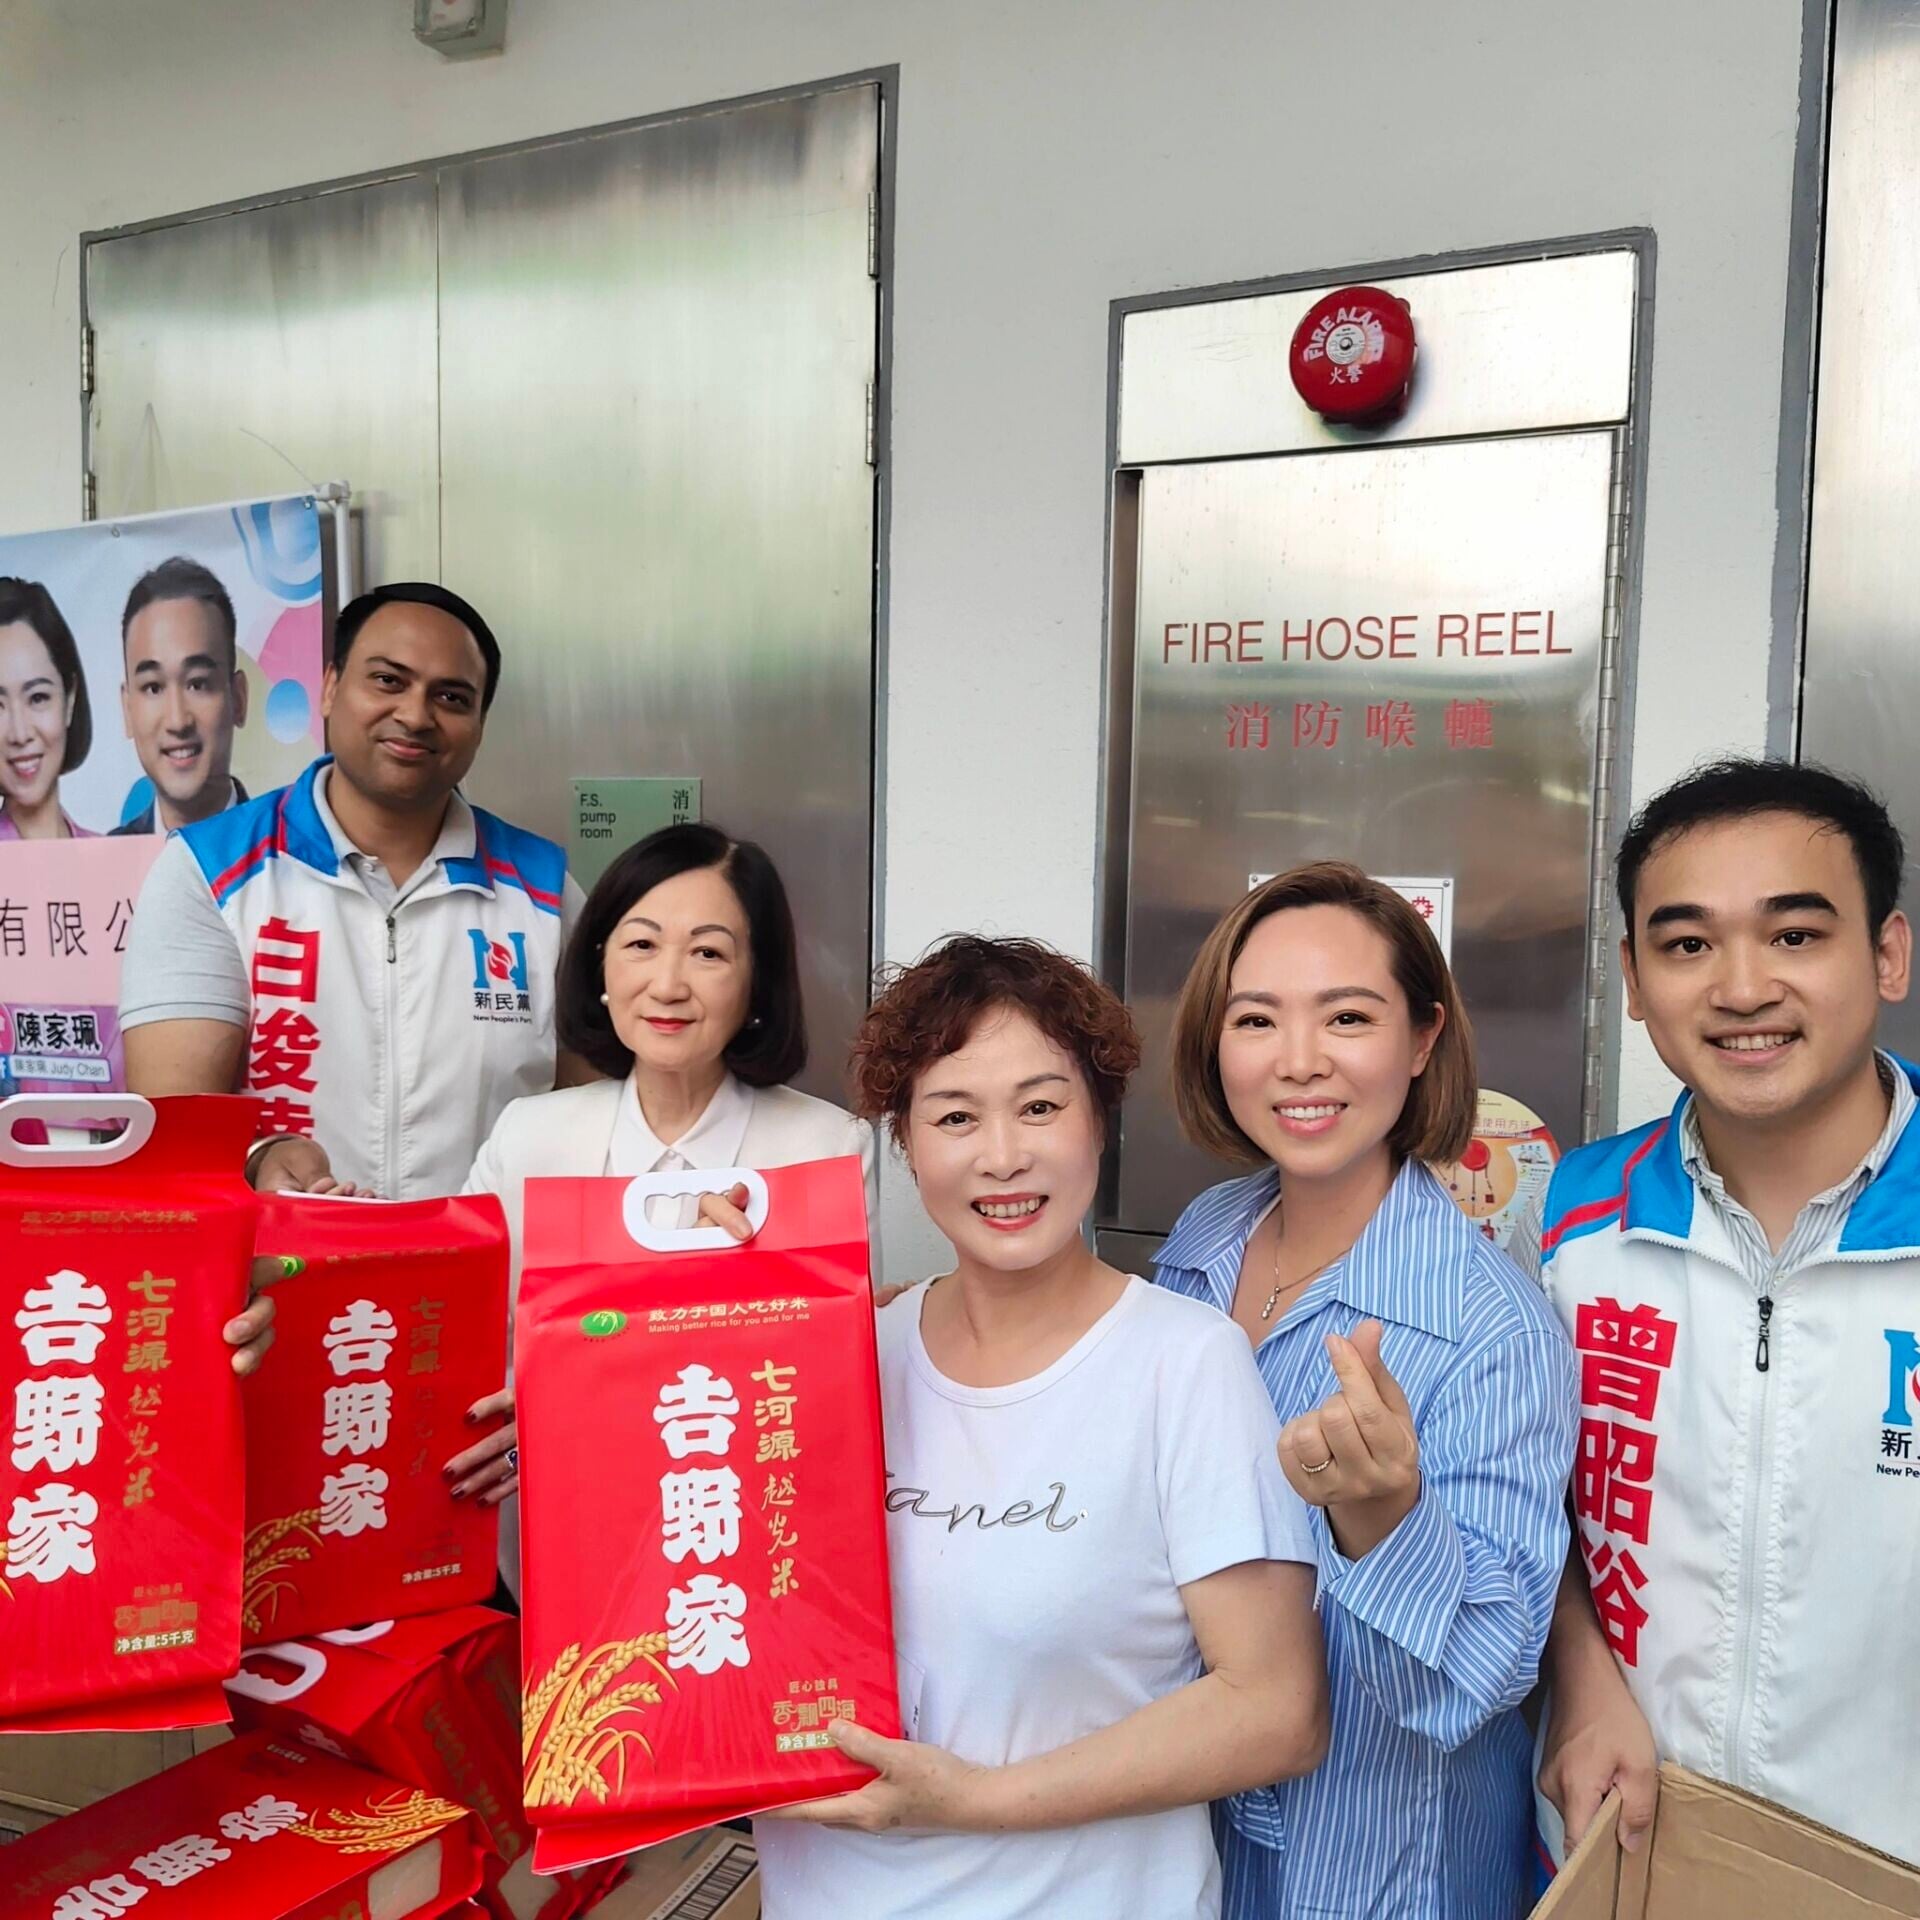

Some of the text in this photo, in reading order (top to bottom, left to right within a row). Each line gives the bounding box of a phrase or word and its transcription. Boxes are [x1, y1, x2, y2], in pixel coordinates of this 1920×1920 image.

[1303, 316, 1336, 363] FIRE
[1329, 366, 1363, 385] 火警
[1163, 610, 1573, 664] FIRE HOSE REEL
[1224, 697, 1496, 751] 消防喉轆
[580, 793, 602, 807] F.S.
[580, 812, 616, 825] pump
[580, 827, 613, 838] room
[16, 1012, 100, 1051] 陳家珮
[51, 1061, 75, 1078] Judy
[76, 1062, 105, 1077] Chan
[648, 1297, 809, 1323] 致力于国人吃好米
[648, 1312, 810, 1334] Making better rice for you and for me
[4, 1269, 112, 1583] 吉野家
[318, 1299, 398, 1537] 吉野家
[1876, 1463, 1902, 1477] New
[885, 1472, 1078, 1534] anel
[652, 1363, 752, 1676] 吉野家
[779, 1732, 832, 1750] 净含量:5
